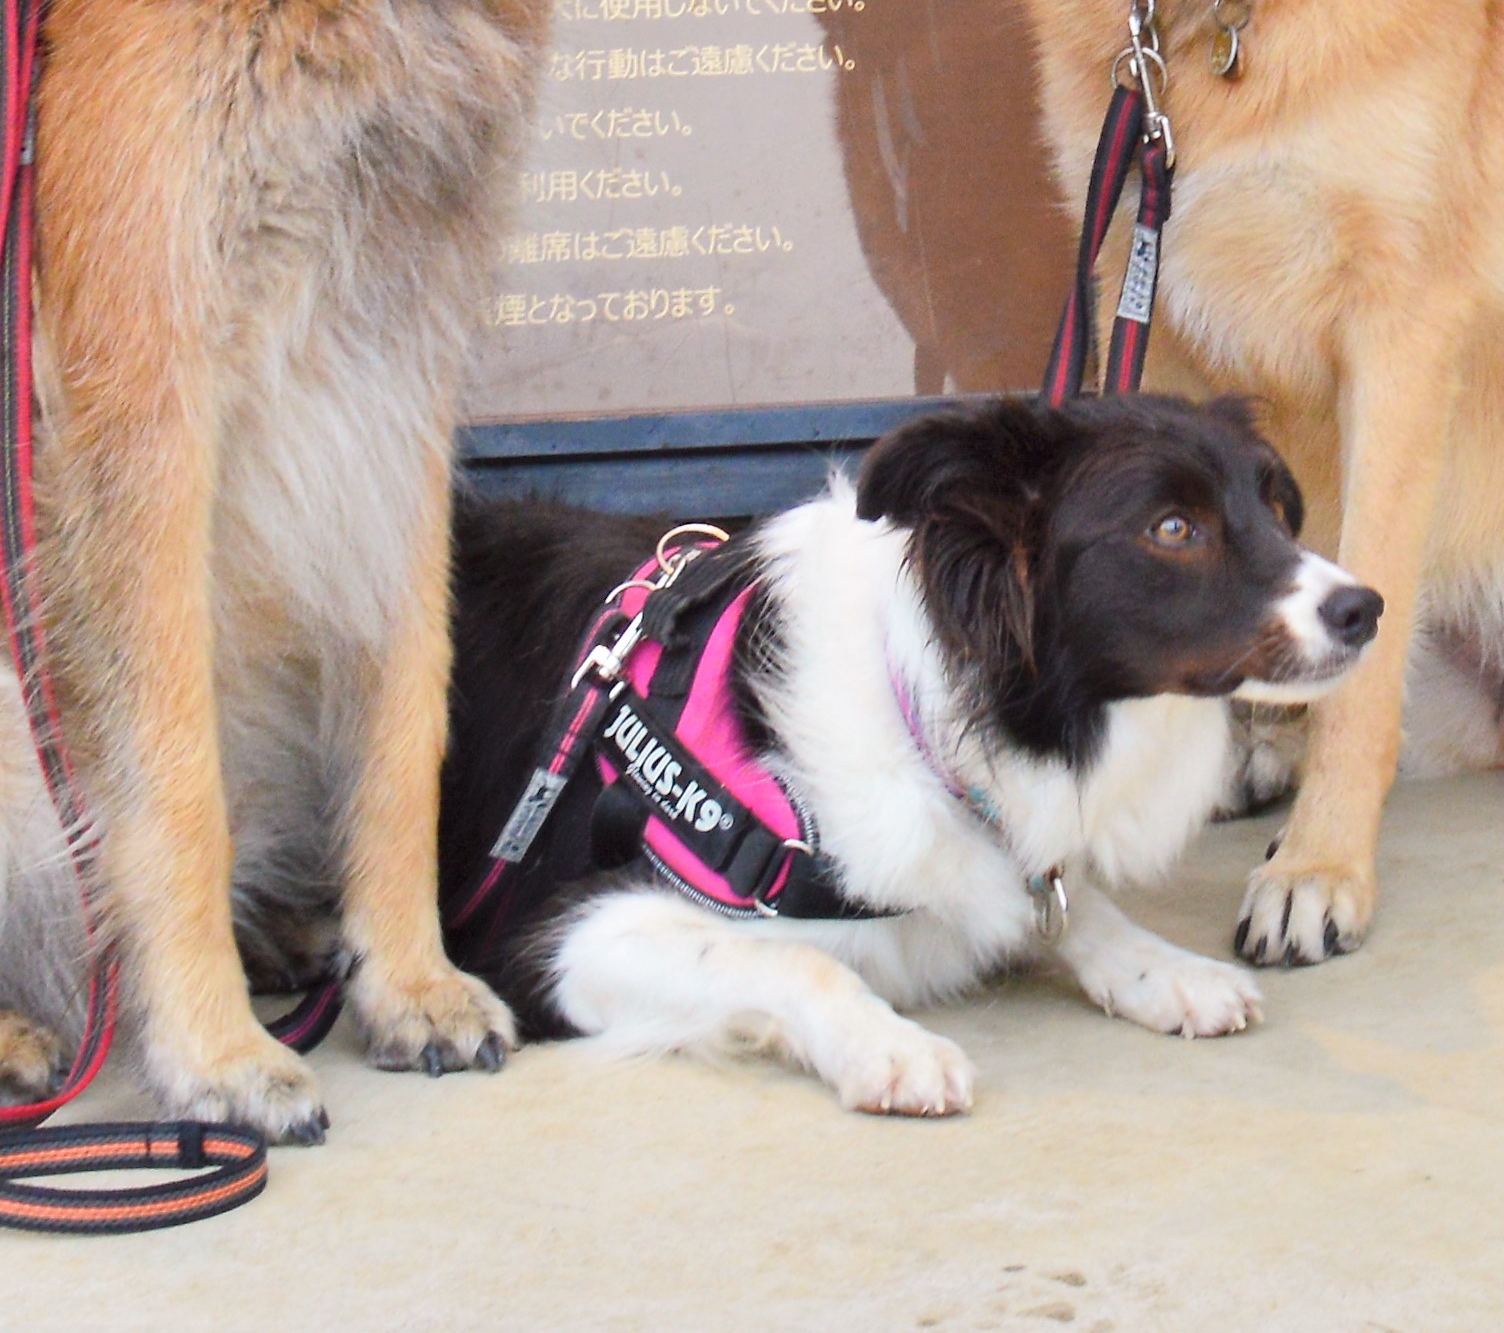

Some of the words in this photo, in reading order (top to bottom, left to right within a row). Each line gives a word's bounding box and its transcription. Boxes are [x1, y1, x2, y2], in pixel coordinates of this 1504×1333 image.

[490, 284, 736, 326] 煙となっております。
